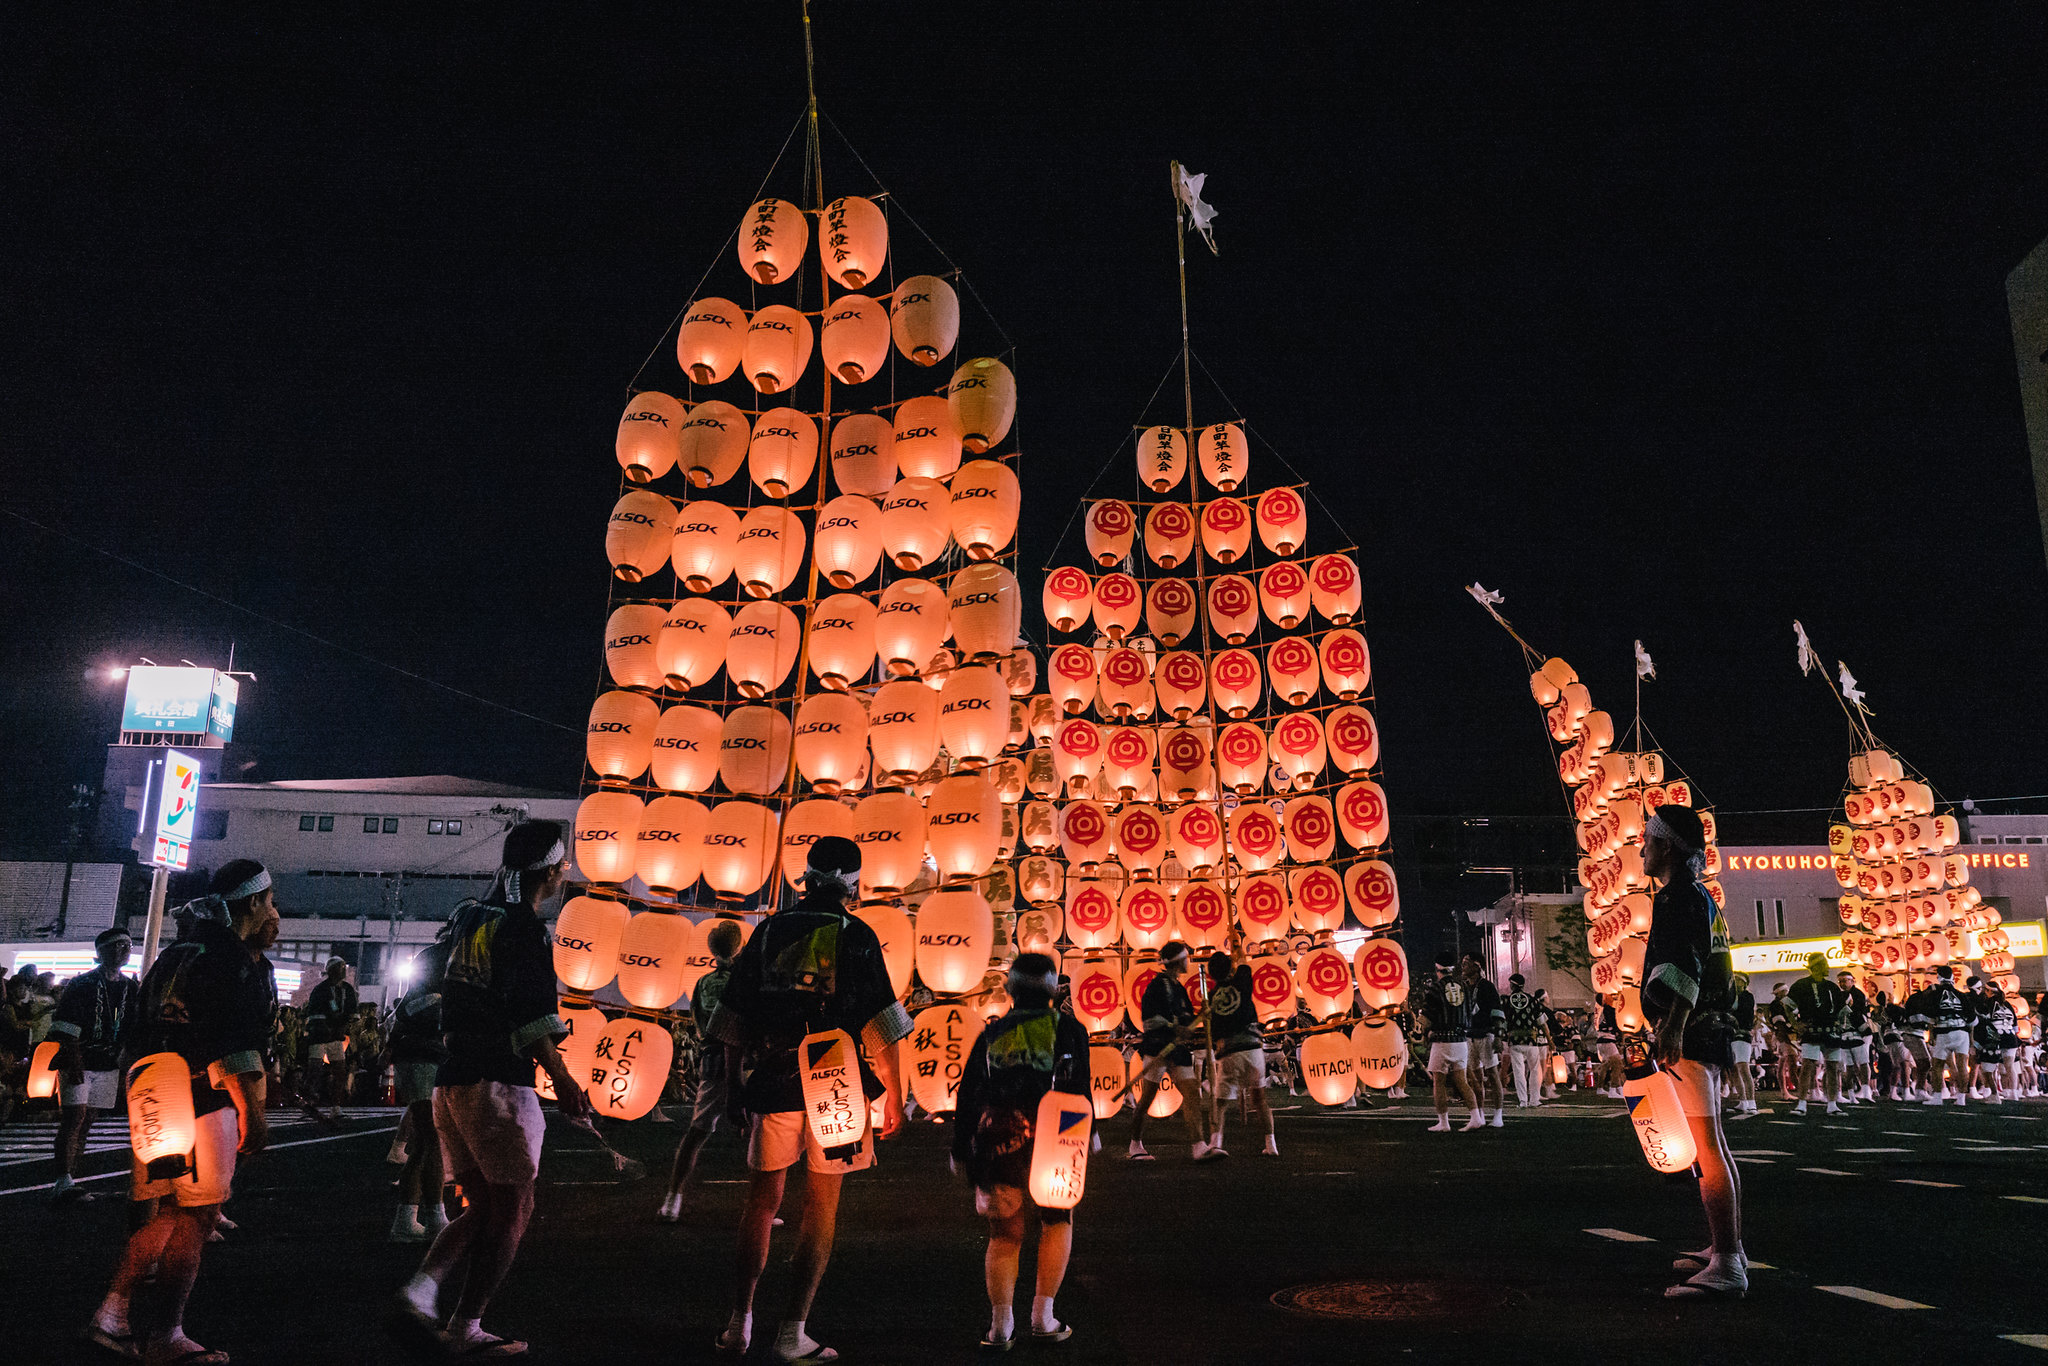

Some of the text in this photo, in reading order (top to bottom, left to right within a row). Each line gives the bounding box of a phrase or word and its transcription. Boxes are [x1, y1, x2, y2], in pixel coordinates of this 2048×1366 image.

[891, 294, 930, 317] ALSOK
[685, 313, 732, 330] ALSOK
[748, 321, 793, 336] ALSOK
[822, 310, 862, 332] ALSOK
[623, 411, 670, 429] ALSOK
[681, 419, 727, 433] ALSOK
[753, 427, 798, 442] ALSOK
[895, 427, 937, 443] ALSOK
[833, 445, 877, 460] ALSOK
[951, 488, 998, 503] ALSOK
[882, 499, 928, 515] ALSOK
[610, 513, 656, 528] ALSOK
[816, 517, 859, 534] ALSOK
[674, 523, 719, 537] ALSOK
[737, 528, 780, 543] ALSOK
[951, 592, 999, 610] ALSOK
[877, 602, 923, 617] ALSOK
[662, 619, 707, 634] ALSOK
[729, 625, 776, 640] ALSOK
[811, 618, 854, 632] ALSOK
[607, 635, 652, 650] ALSOK
[942, 698, 991, 715] ALSOK
[871, 711, 916, 727] ALSOK
[588, 722, 632, 735] ALSOK
[795, 722, 841, 738] ALSOK
[653, 738, 699, 752] ALSOK
[721, 738, 767, 751] ALSOK
[929, 812, 980, 826] ALSOK
[575, 830, 618, 841] ALSOK
[637, 830, 682, 843] ALSOK
[703, 834, 747, 848] ALSOK
[784, 834, 822, 846] ALSO
[854, 830, 903, 843] ALSOK
[1728, 855, 1853, 870] KYOKUHOK
[553, 933, 593, 952] ALSOK
[920, 934, 971, 947] ALSOK
[619, 953, 662, 968] ALSOK
[685, 956, 717, 968] ALSO
[1777, 950, 1810, 963] Time
[1360, 1051, 1403, 1070] HITACH
[610, 1028, 643, 1109] ALSOK
[811, 1067, 846, 1080] ALSOK
